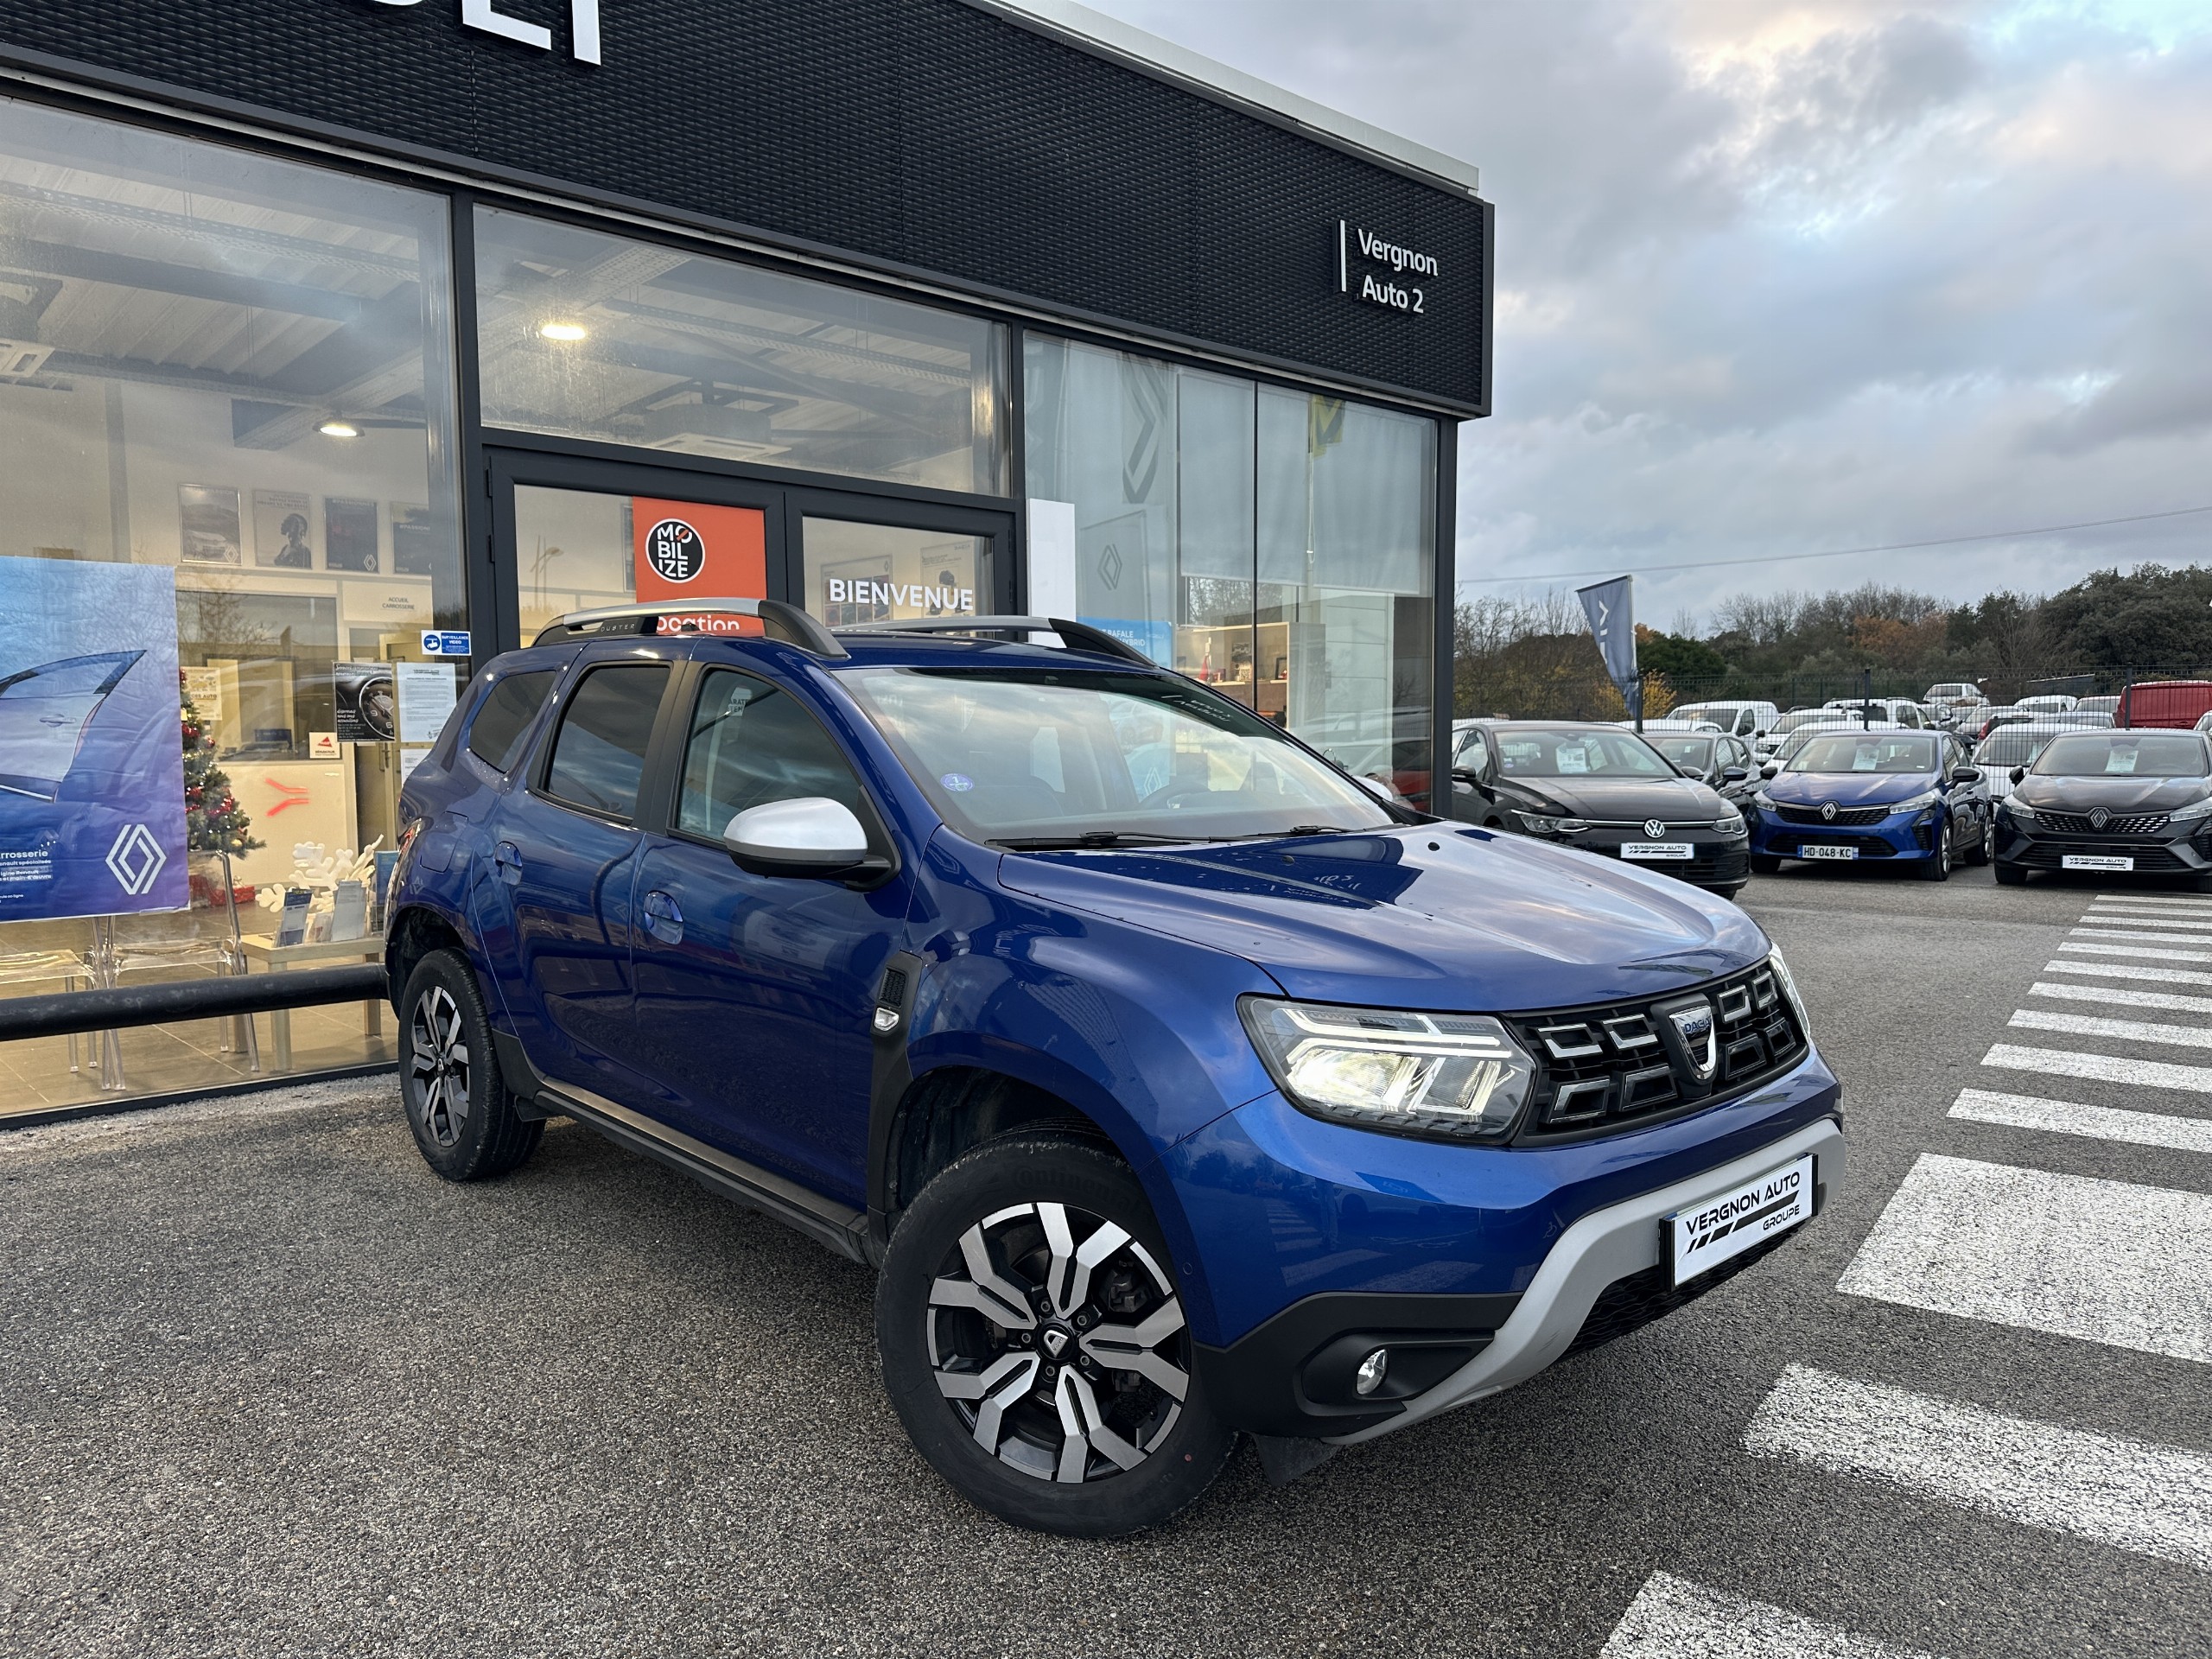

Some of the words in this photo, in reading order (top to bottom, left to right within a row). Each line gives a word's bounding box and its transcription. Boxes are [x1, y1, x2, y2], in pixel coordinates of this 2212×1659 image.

[1357, 228, 1439, 276] Vergnon
[1362, 275, 1408, 309] Auto
[1412, 288, 1424, 314] 2
[830, 578, 974, 611] BIENVENUE
[601, 624, 636, 632] DUSTER
[656, 614, 741, 632] oction
[1109, 630, 1134, 639] RAFALE
[0, 849, 48, 859] rrosserie
[1803, 847, 1852, 858] HD-048-KC
[1684, 1017, 1712, 1033] DACIA
[1686, 1189, 1760, 1236] VERGNON
[1764, 1171, 1801, 1202] AUTO
[1763, 1204, 1801, 1231] GROUPE
